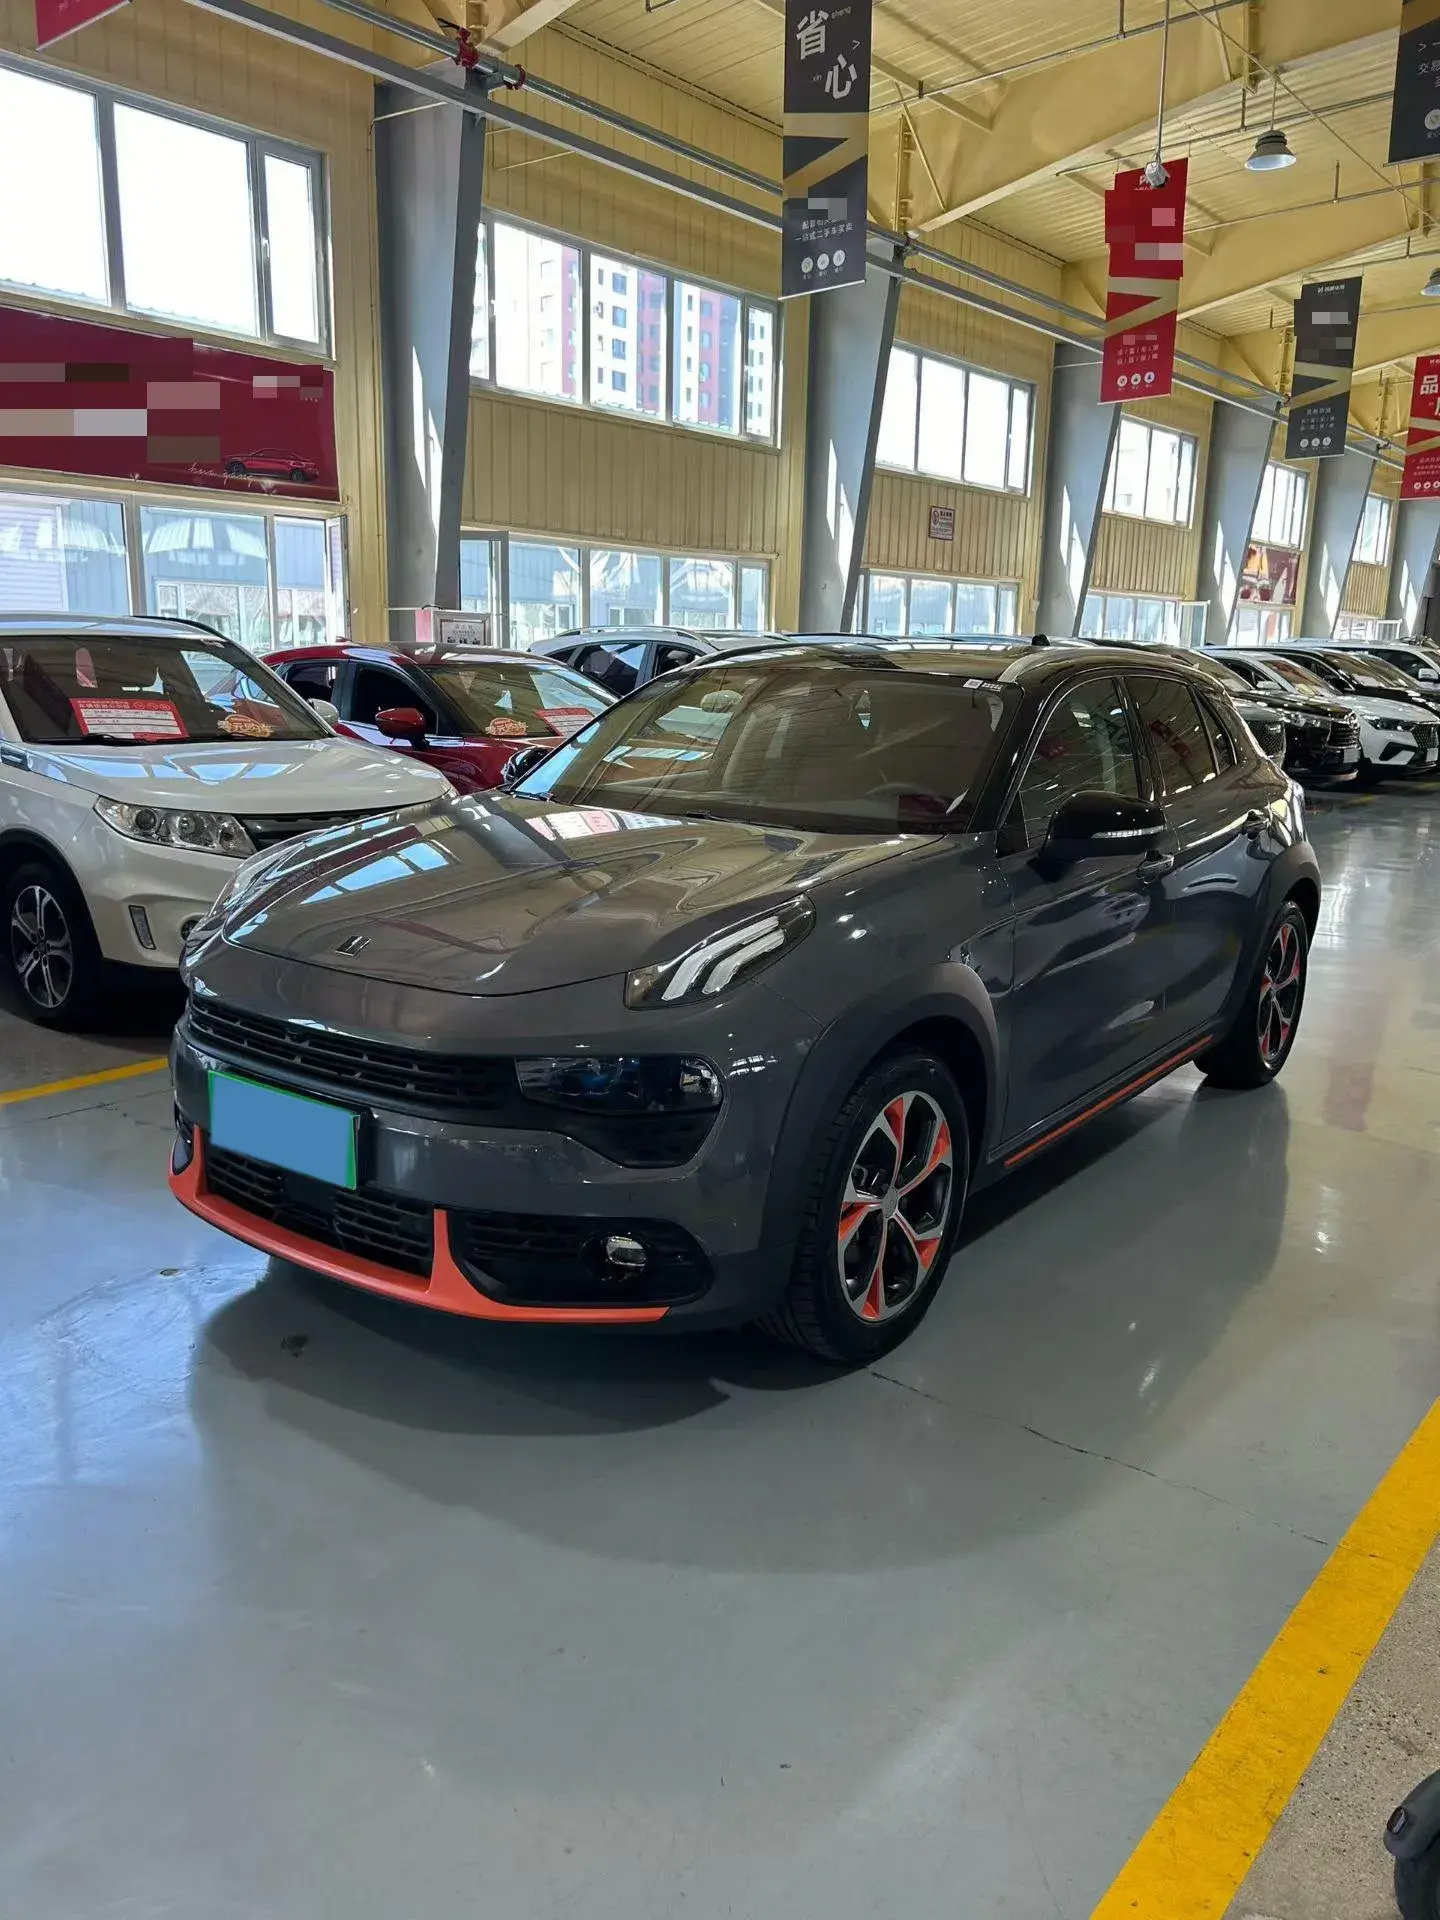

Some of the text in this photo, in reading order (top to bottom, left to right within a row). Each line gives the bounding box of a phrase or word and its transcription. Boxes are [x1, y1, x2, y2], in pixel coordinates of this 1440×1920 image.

[796, 10, 829, 60] 省
[824, 53, 858, 99] 心
[1420, 375, 1439, 395] 品
